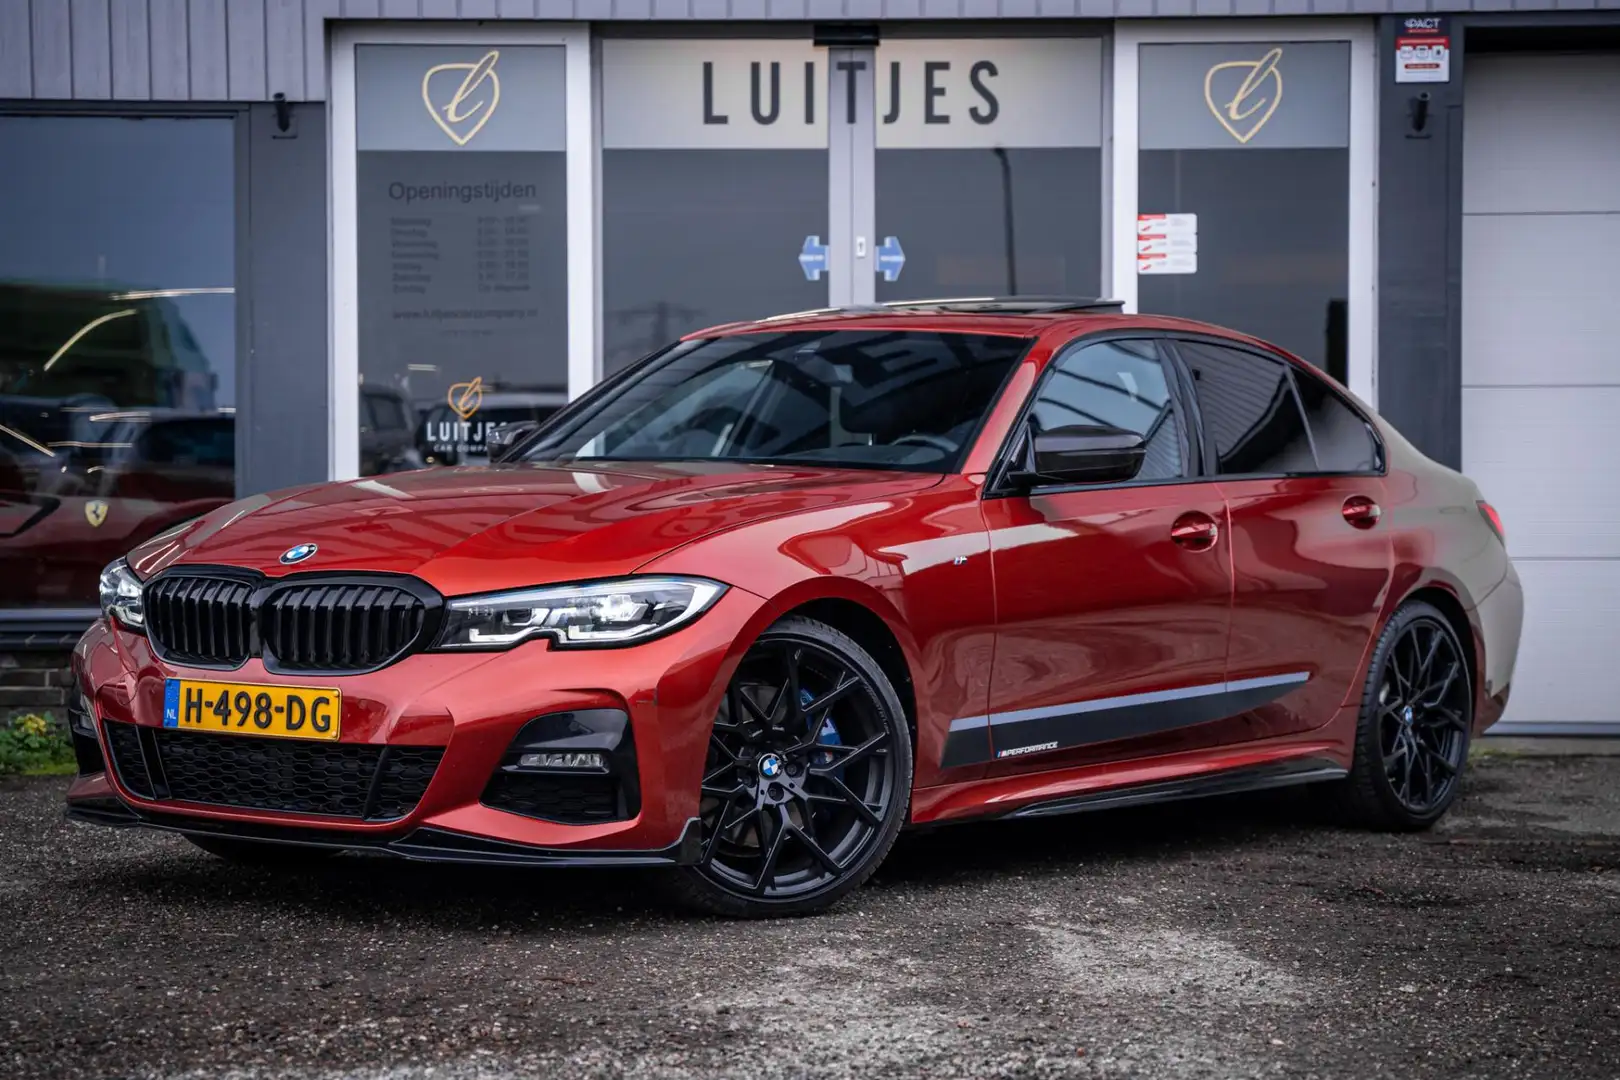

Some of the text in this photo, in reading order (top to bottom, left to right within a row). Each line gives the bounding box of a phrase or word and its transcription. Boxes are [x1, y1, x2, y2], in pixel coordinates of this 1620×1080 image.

[703, 60, 999, 125] LUITJES
[388, 181, 536, 203] Openingstijden
[166, 708, 176, 720] NL
[185, 687, 332, 732] H-498-DG
